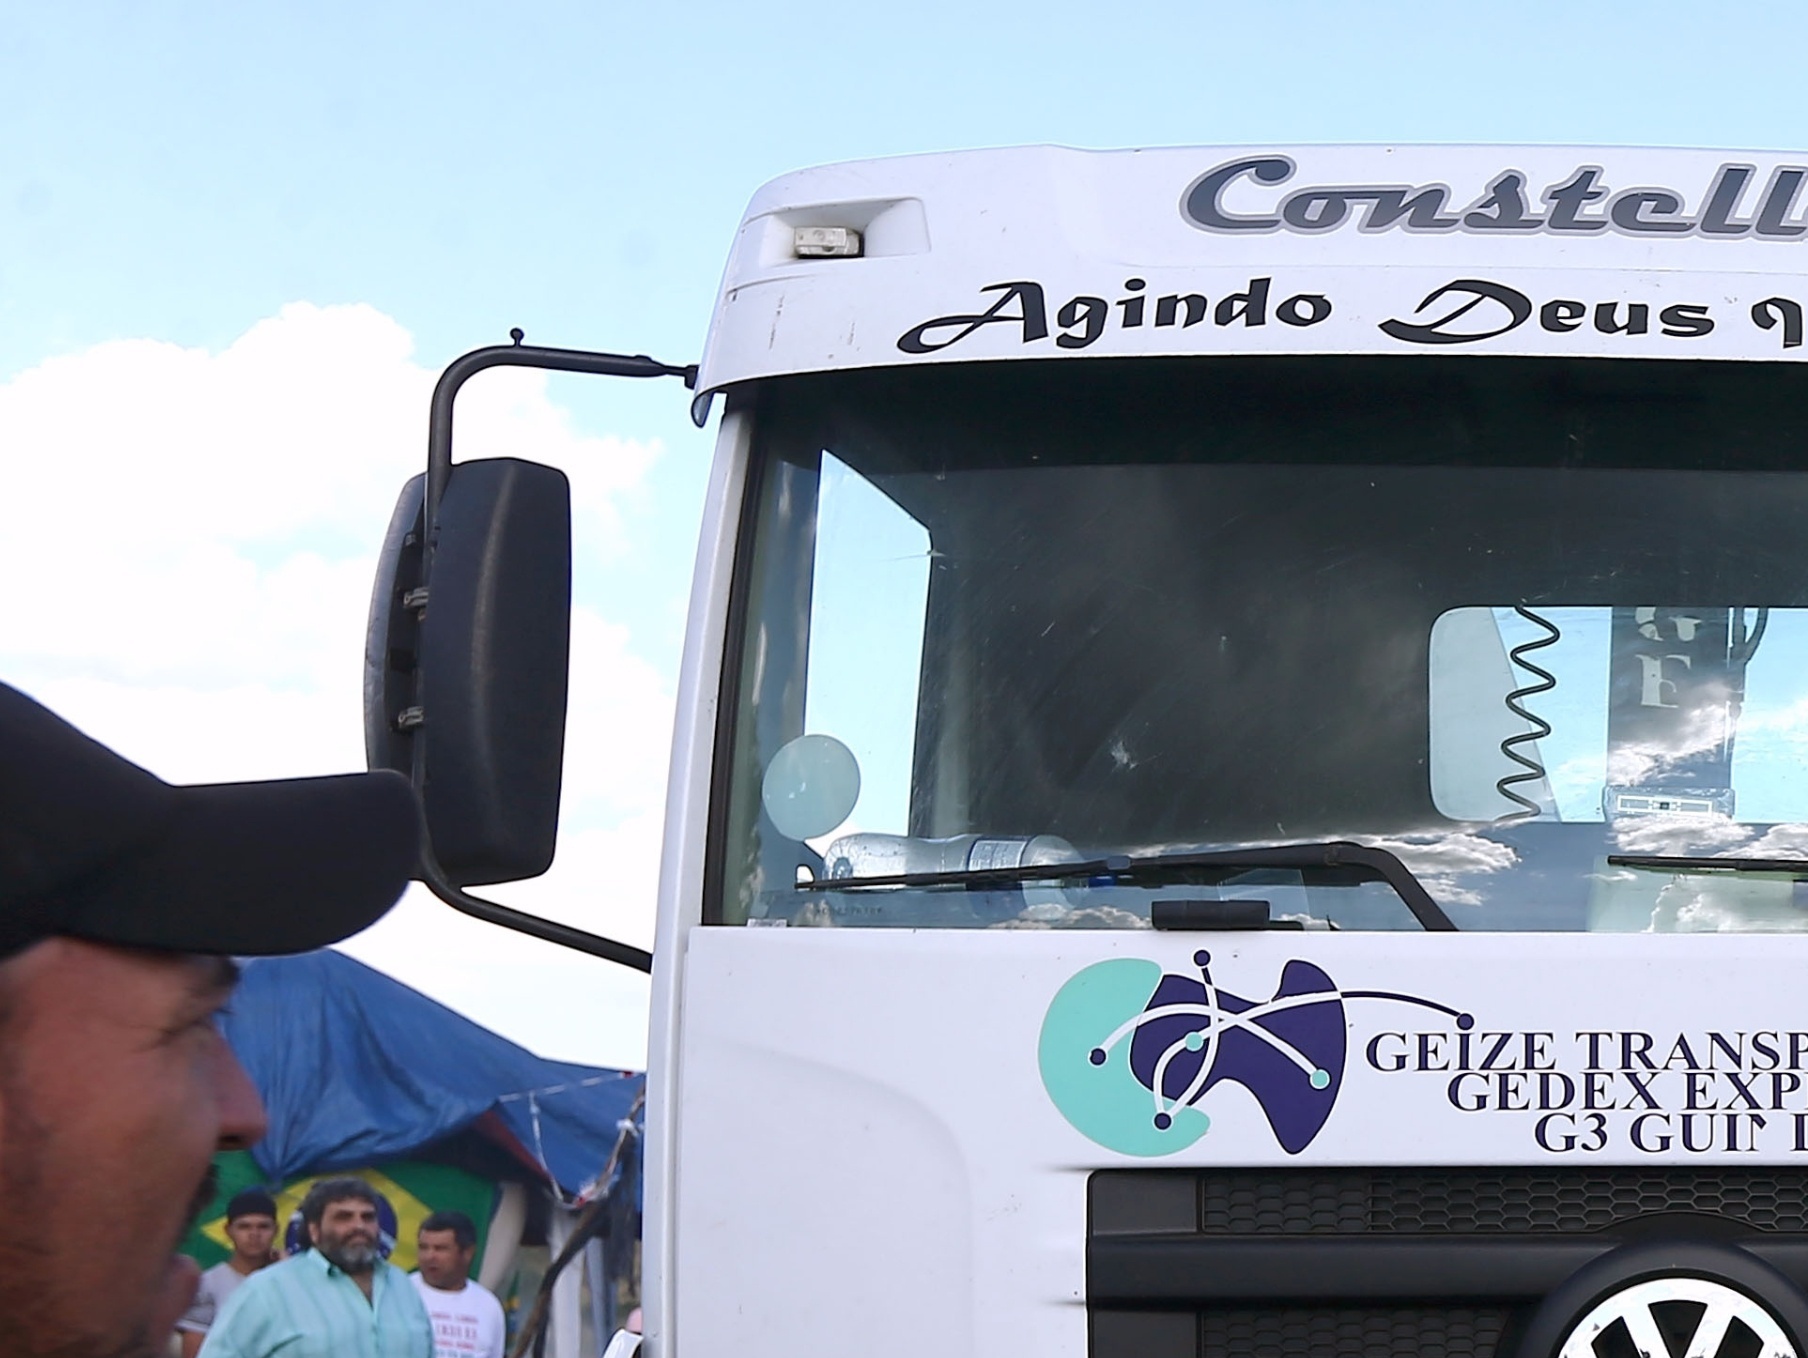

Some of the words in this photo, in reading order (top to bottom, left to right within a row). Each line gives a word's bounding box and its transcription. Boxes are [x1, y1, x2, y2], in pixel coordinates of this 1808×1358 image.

[896, 276, 1333, 354] Agindo
[1377, 279, 1715, 345] Deus
[1365, 1031, 1557, 1072] GEIZE
[1447, 1072, 1663, 1111] GEDEX
[1534, 1112, 1608, 1153] G3
